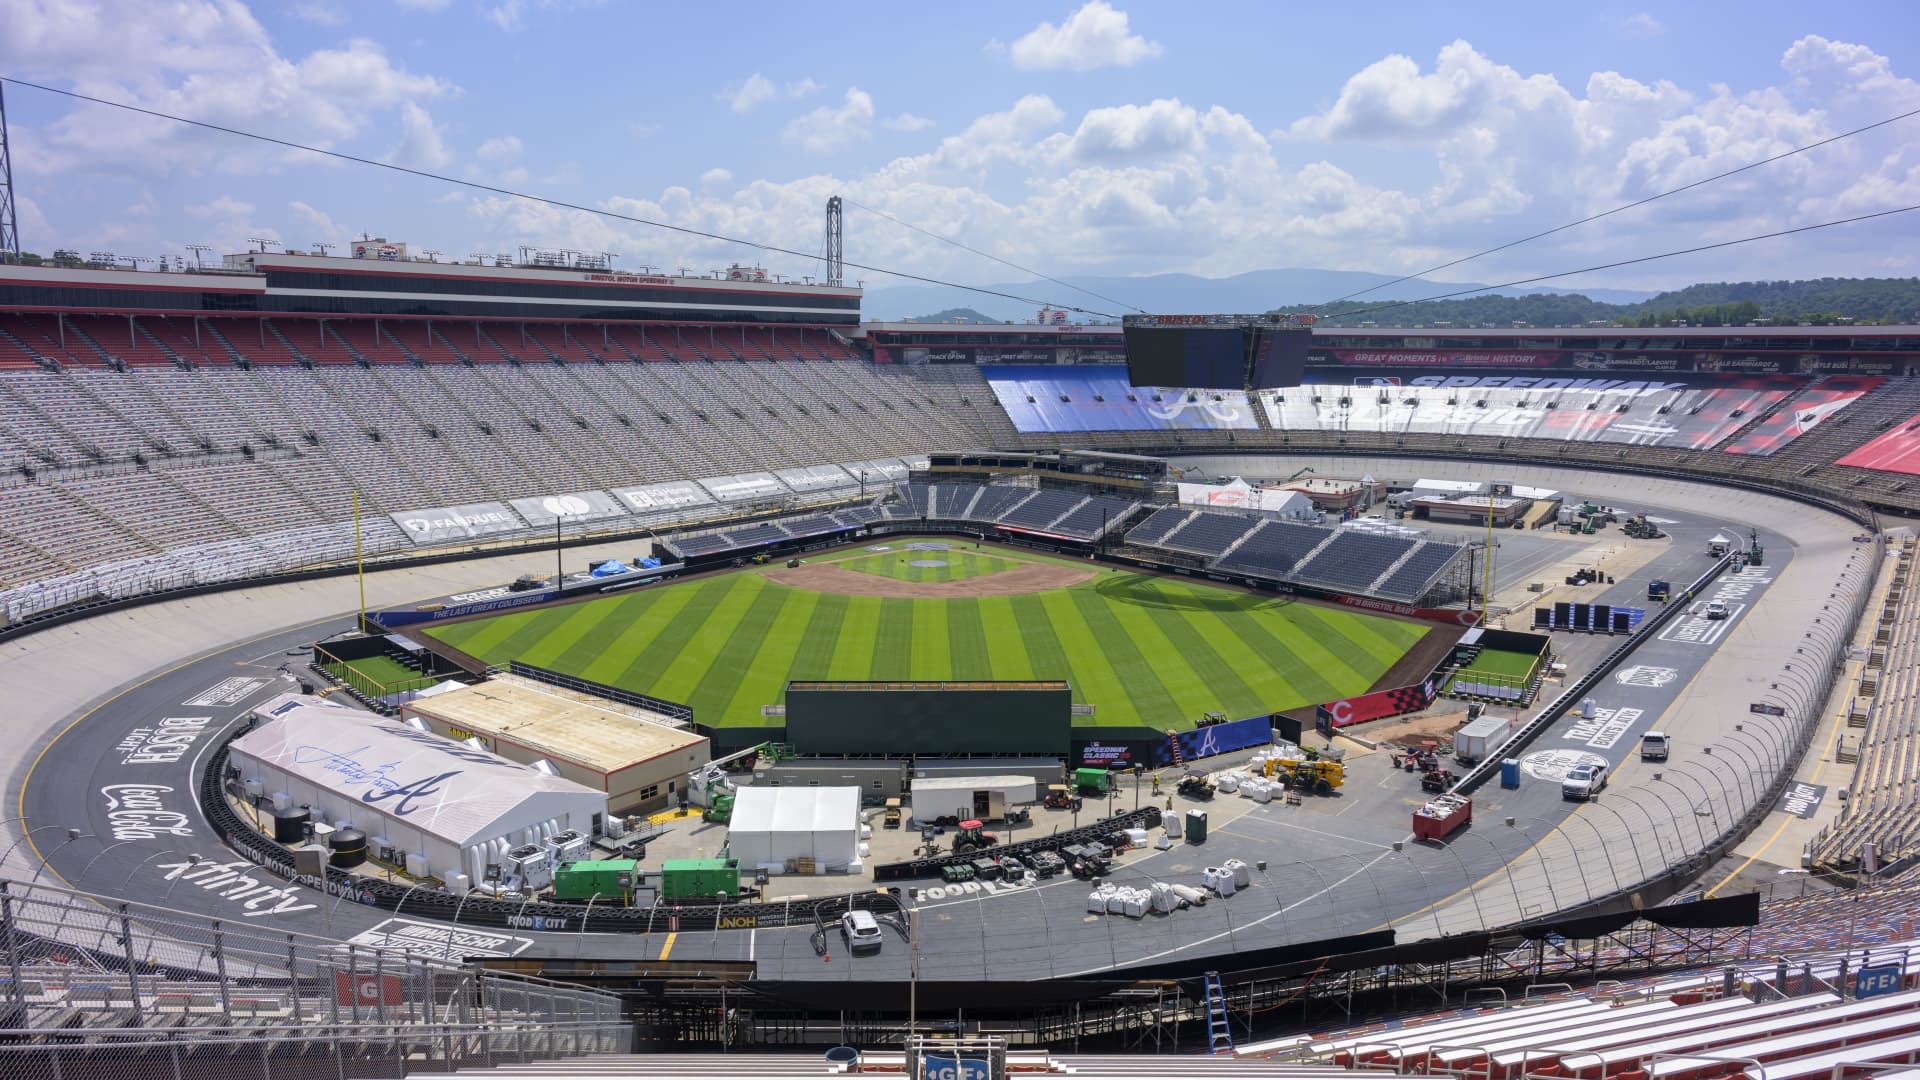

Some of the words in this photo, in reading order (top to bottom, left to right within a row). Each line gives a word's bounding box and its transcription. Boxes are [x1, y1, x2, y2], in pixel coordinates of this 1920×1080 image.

[591, 274, 615, 282] BRISTOL
[640, 277, 669, 285] SPEEDWAY
[1157, 315, 1209, 325] BRISTOL
[1354, 354, 1386, 362] GREAT
[1388, 354, 1437, 362] MOMENTS
[1492, 355, 1537, 363] HISTORY
[1410, 375, 1688, 398] SPEEDWAY
[433, 610, 450, 619] THE
[450, 607, 471, 617] LAST
[471, 603, 497, 614] GREAT
[498, 594, 545, 609] COLOSSEUM
[1361, 599, 1394, 612] BRISTOL
[1394, 604, 1417, 616] BABY
[1331, 700, 1353, 723] C
[1562, 706, 1617, 741] TRACKER
[121, 716, 213, 765] BUSCH
[1083, 745, 1129, 753] SPEEDWAY
[233, 838, 264, 866] BRISTOL
[265, 857, 298, 879] MOTOR
[300, 873, 363, 903] SPEEDWAY
[156, 858, 318, 917] xfinity
[507, 915, 532, 928] FOOD
[545, 918, 567, 929] CITY
[717, 916, 756, 929] UNOH
[418, 927, 507, 949] NASCAR
